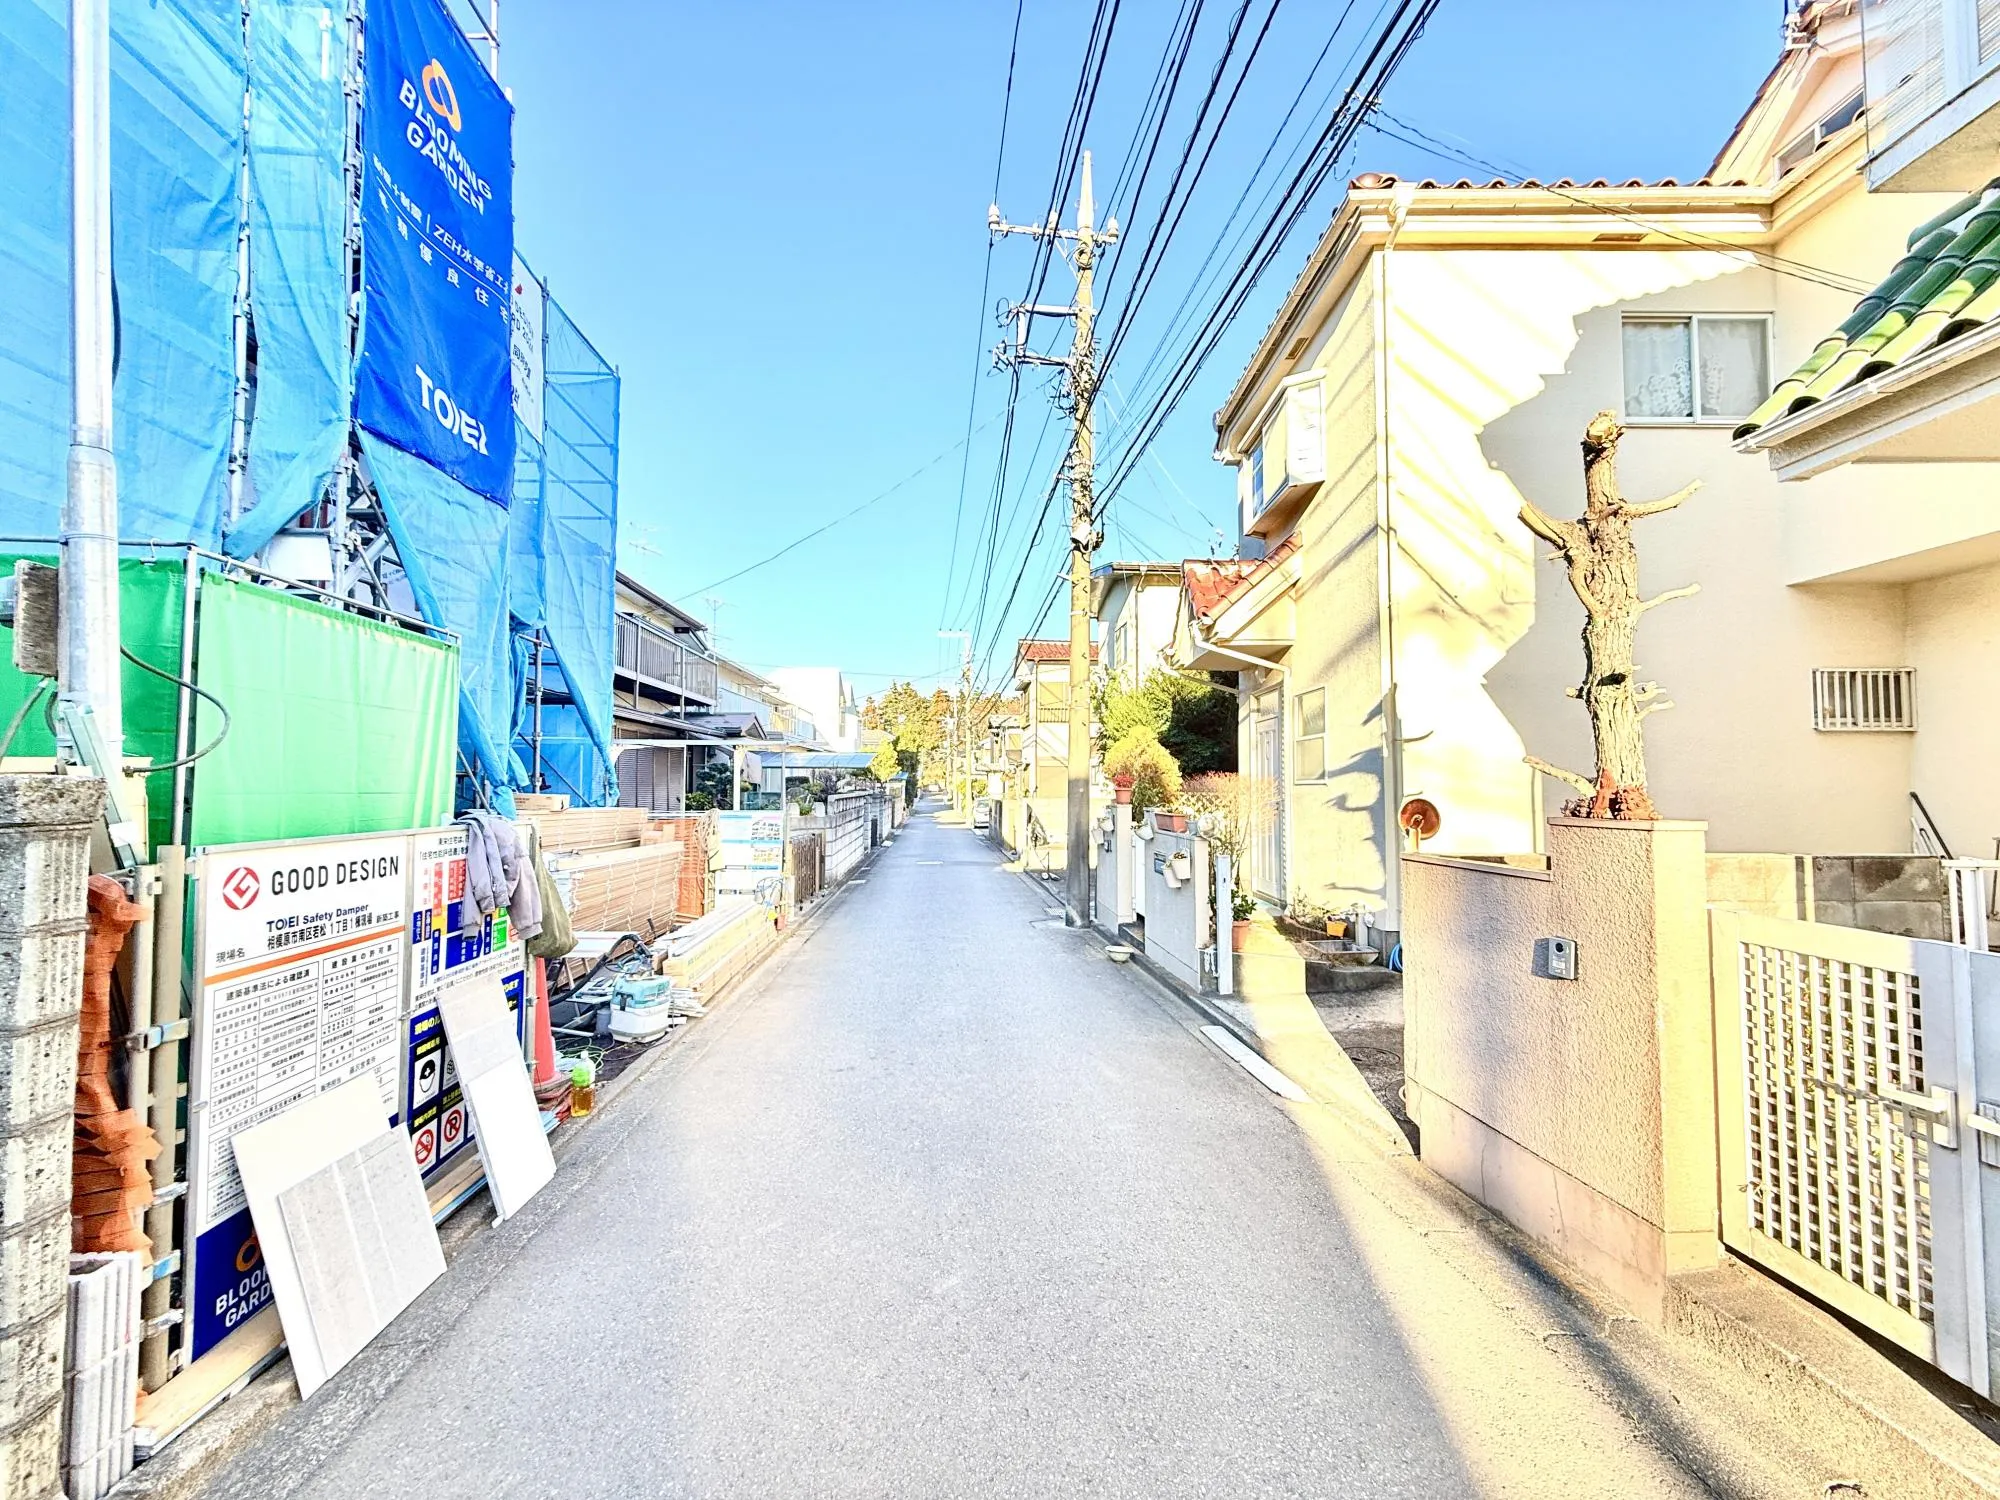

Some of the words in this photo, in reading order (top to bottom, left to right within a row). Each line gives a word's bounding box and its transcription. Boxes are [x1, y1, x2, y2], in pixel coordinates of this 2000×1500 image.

[400, 78, 493, 200] BLOOMING
[406, 121, 485, 215] GARDEN
[271, 865, 329, 896] GOOD
[336, 855, 399, 885] DESIGN
[302, 911, 334, 926] Safety
[336, 904, 369, 919] Damper
[215, 947, 246, 963] 現場名
[225, 1282, 273, 1328] GARD
